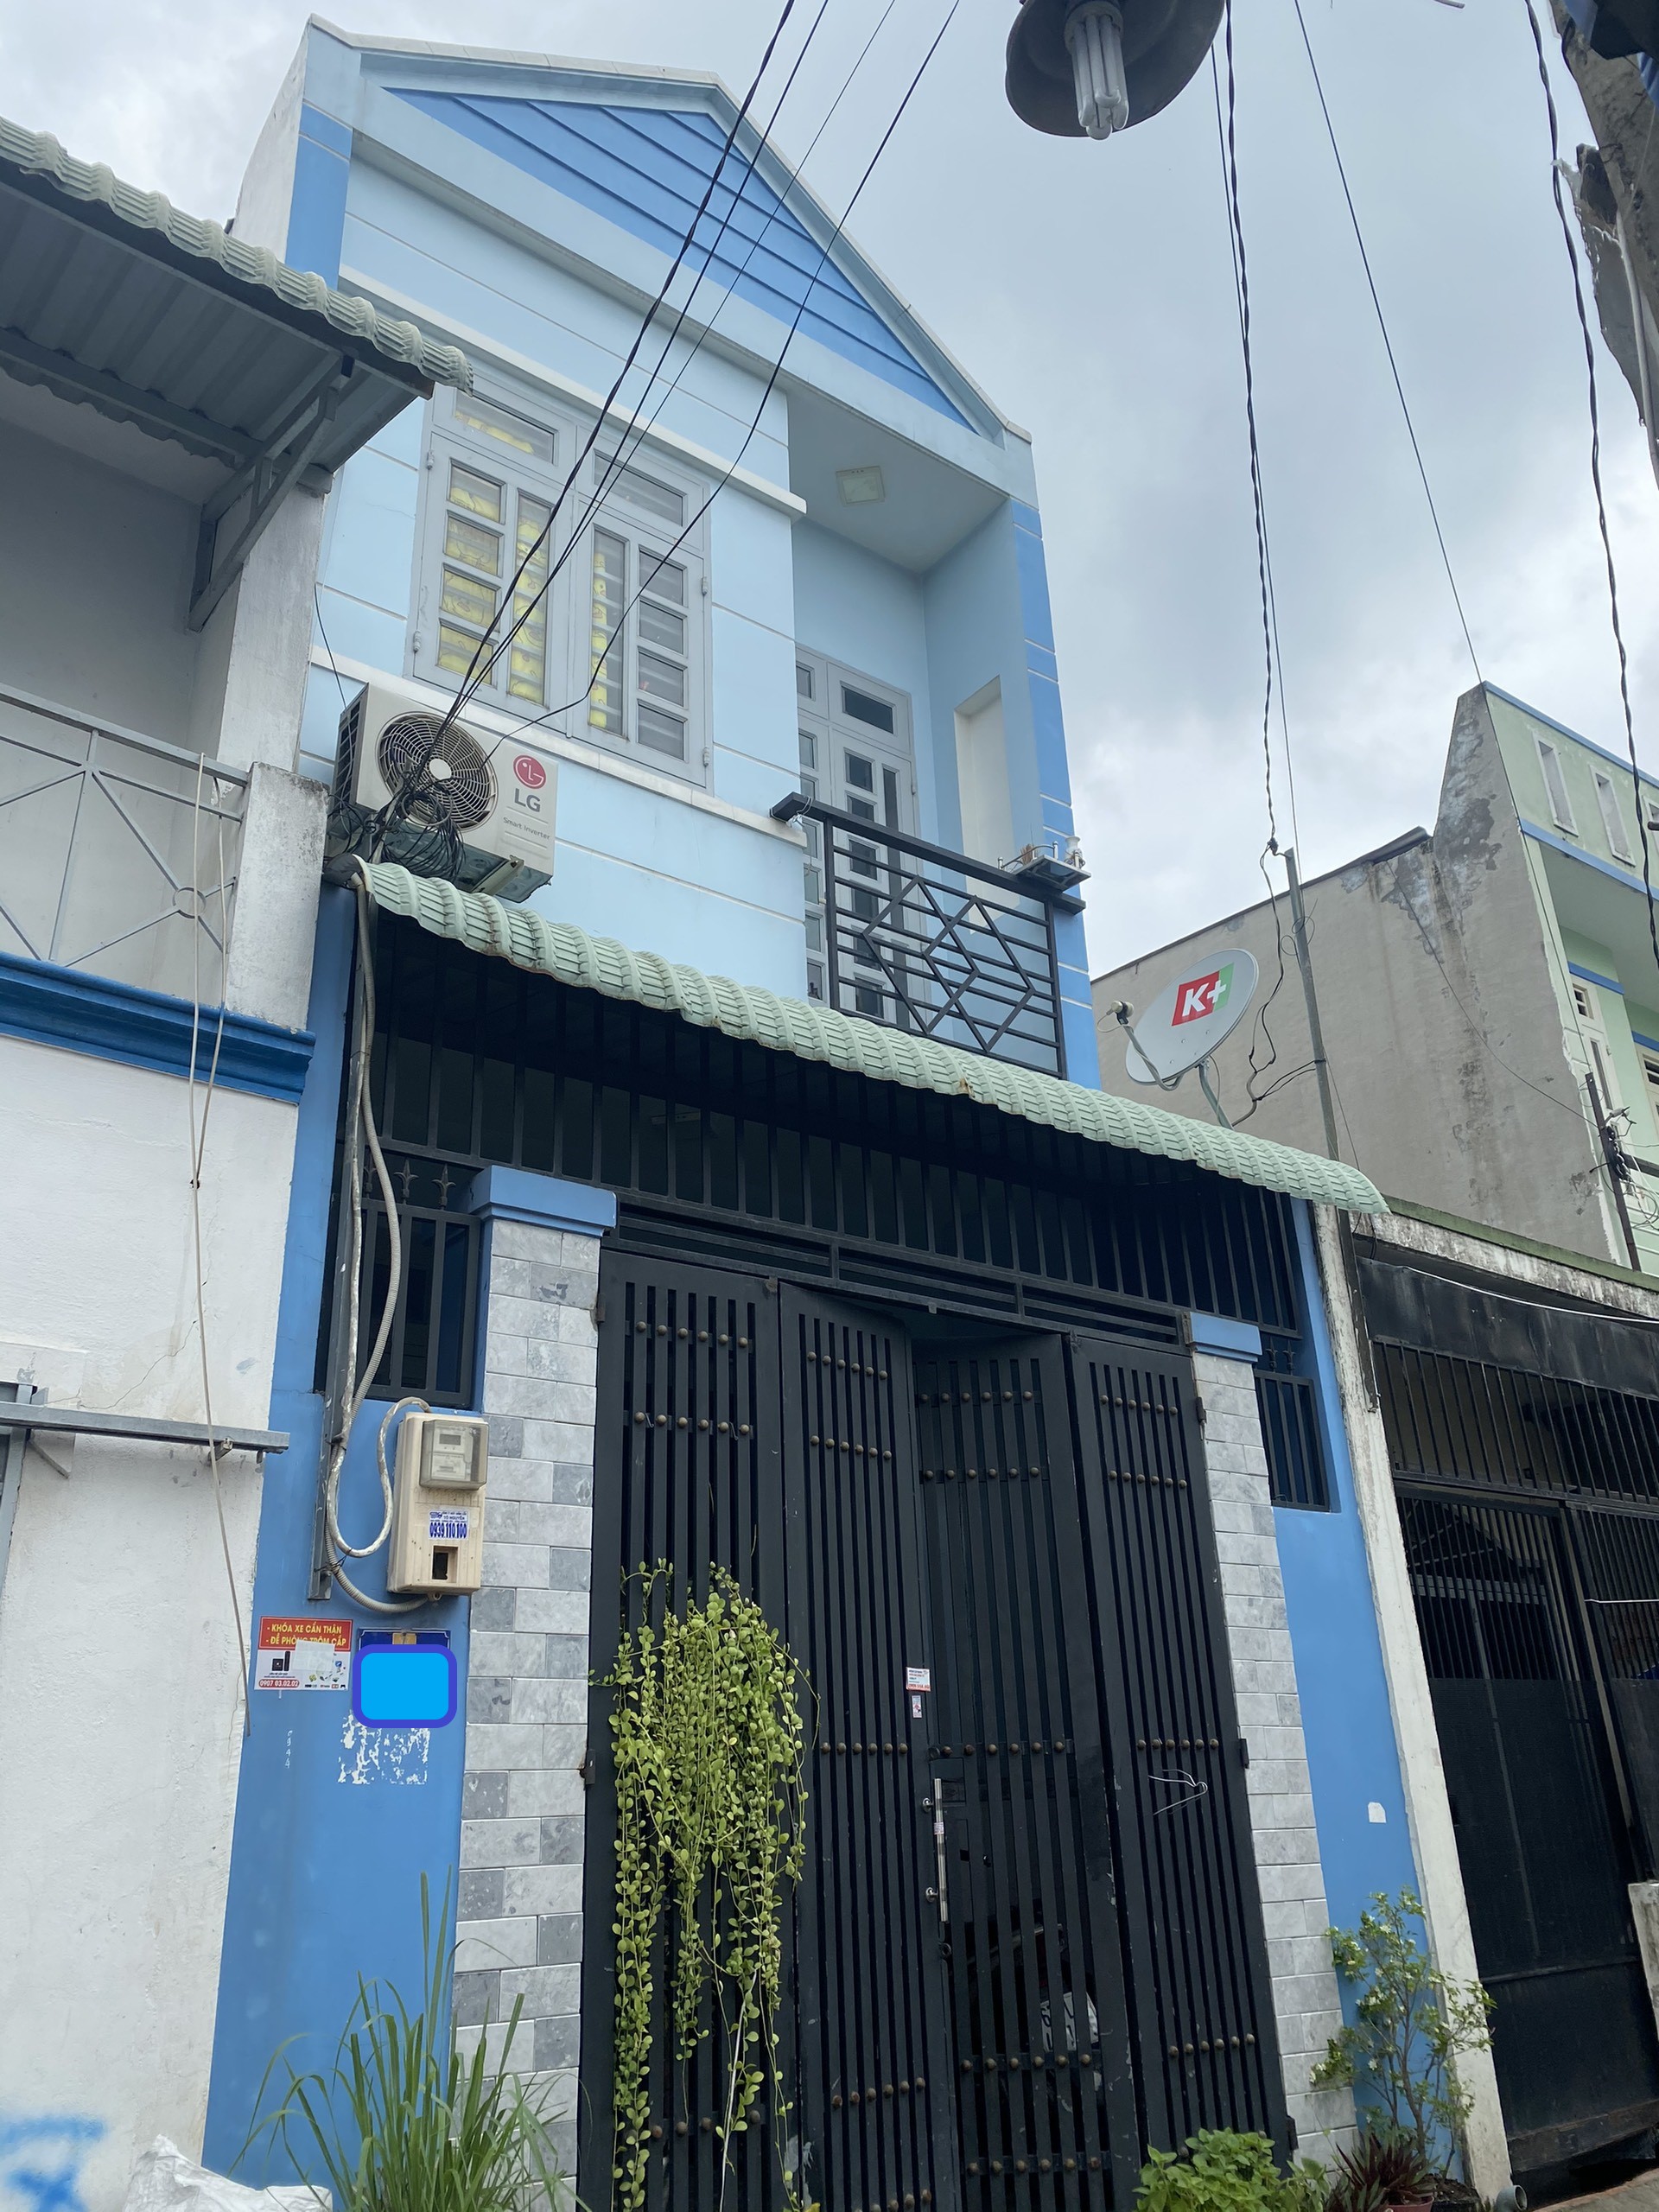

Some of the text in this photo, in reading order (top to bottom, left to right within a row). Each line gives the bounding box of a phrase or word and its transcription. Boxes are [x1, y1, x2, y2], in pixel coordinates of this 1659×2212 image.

[514, 788, 541, 812] LG
[503, 817, 550, 840] Smart Inverter
[1182, 979, 1227, 1017] K+
[271, 1622, 292, 1632] KHÓA
[294, 1624, 303, 1633] XE
[323, 1624, 342, 1637] THẬN
